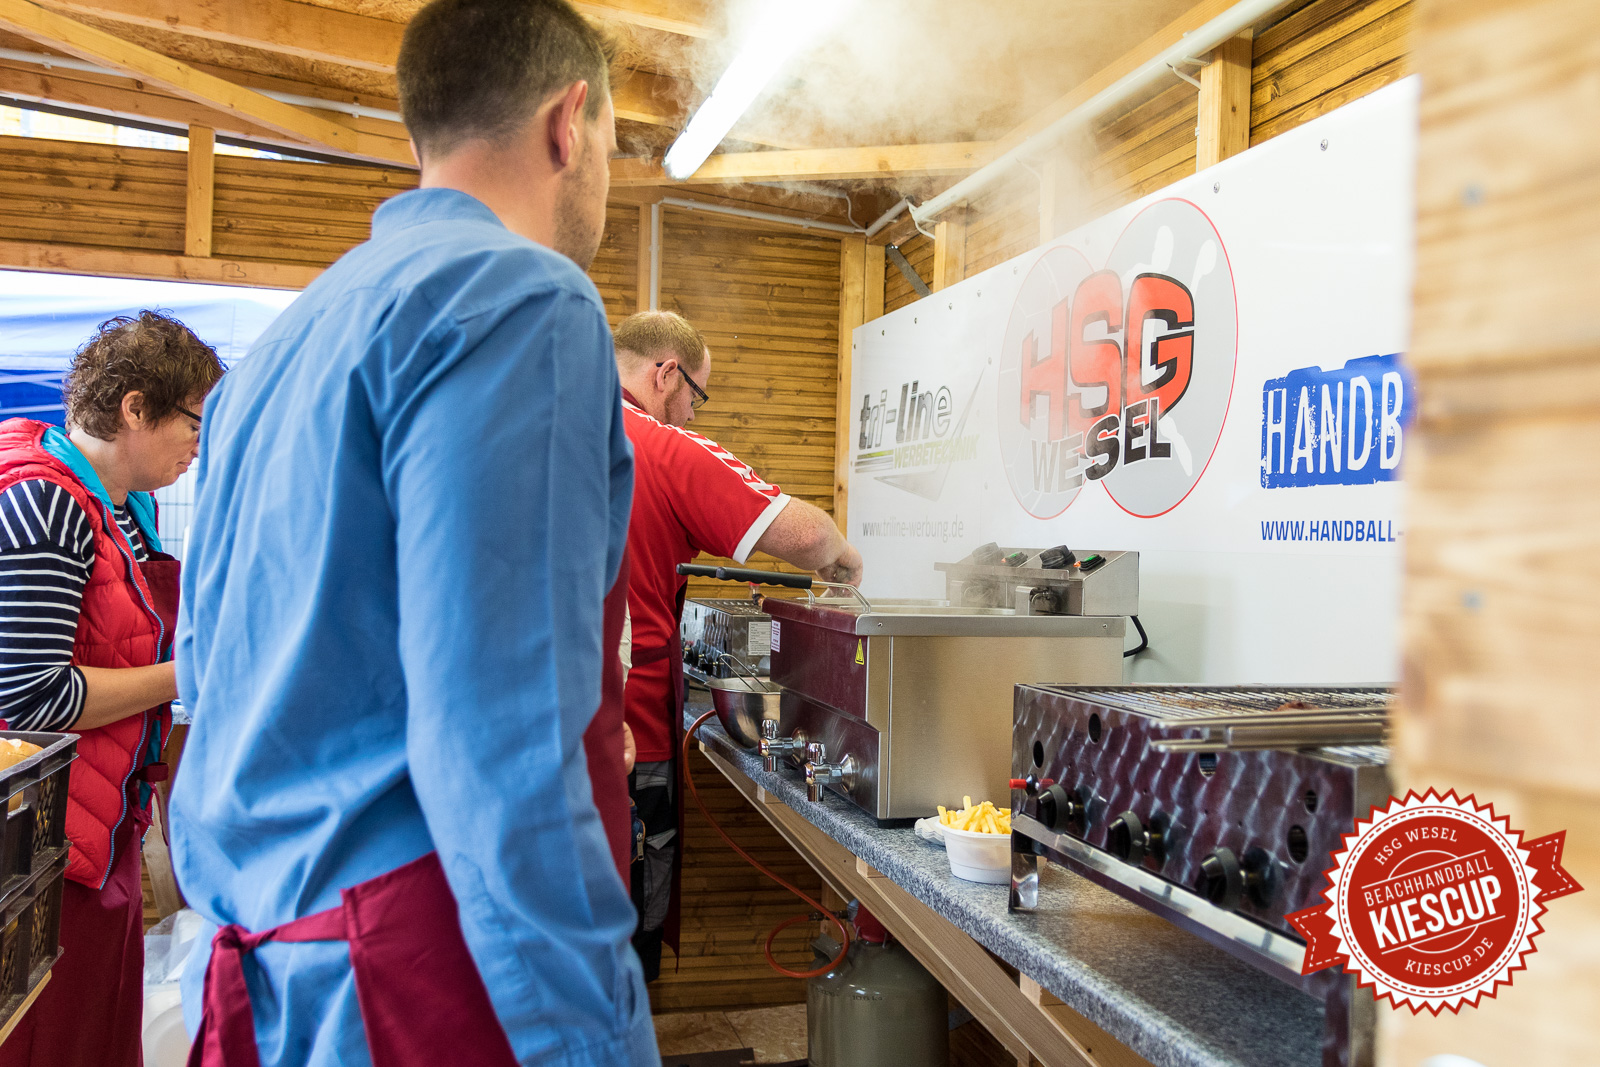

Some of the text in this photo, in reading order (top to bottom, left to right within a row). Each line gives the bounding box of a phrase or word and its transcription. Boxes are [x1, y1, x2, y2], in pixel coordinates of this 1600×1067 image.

[1020, 268, 1195, 460] HSG
[858, 380, 953, 451] tri-line
[1031, 396, 1172, 494] WESEL
[894, 434, 981, 470] WERBETECHNIK
[862, 513, 964, 543] www.triline-werbung.de
